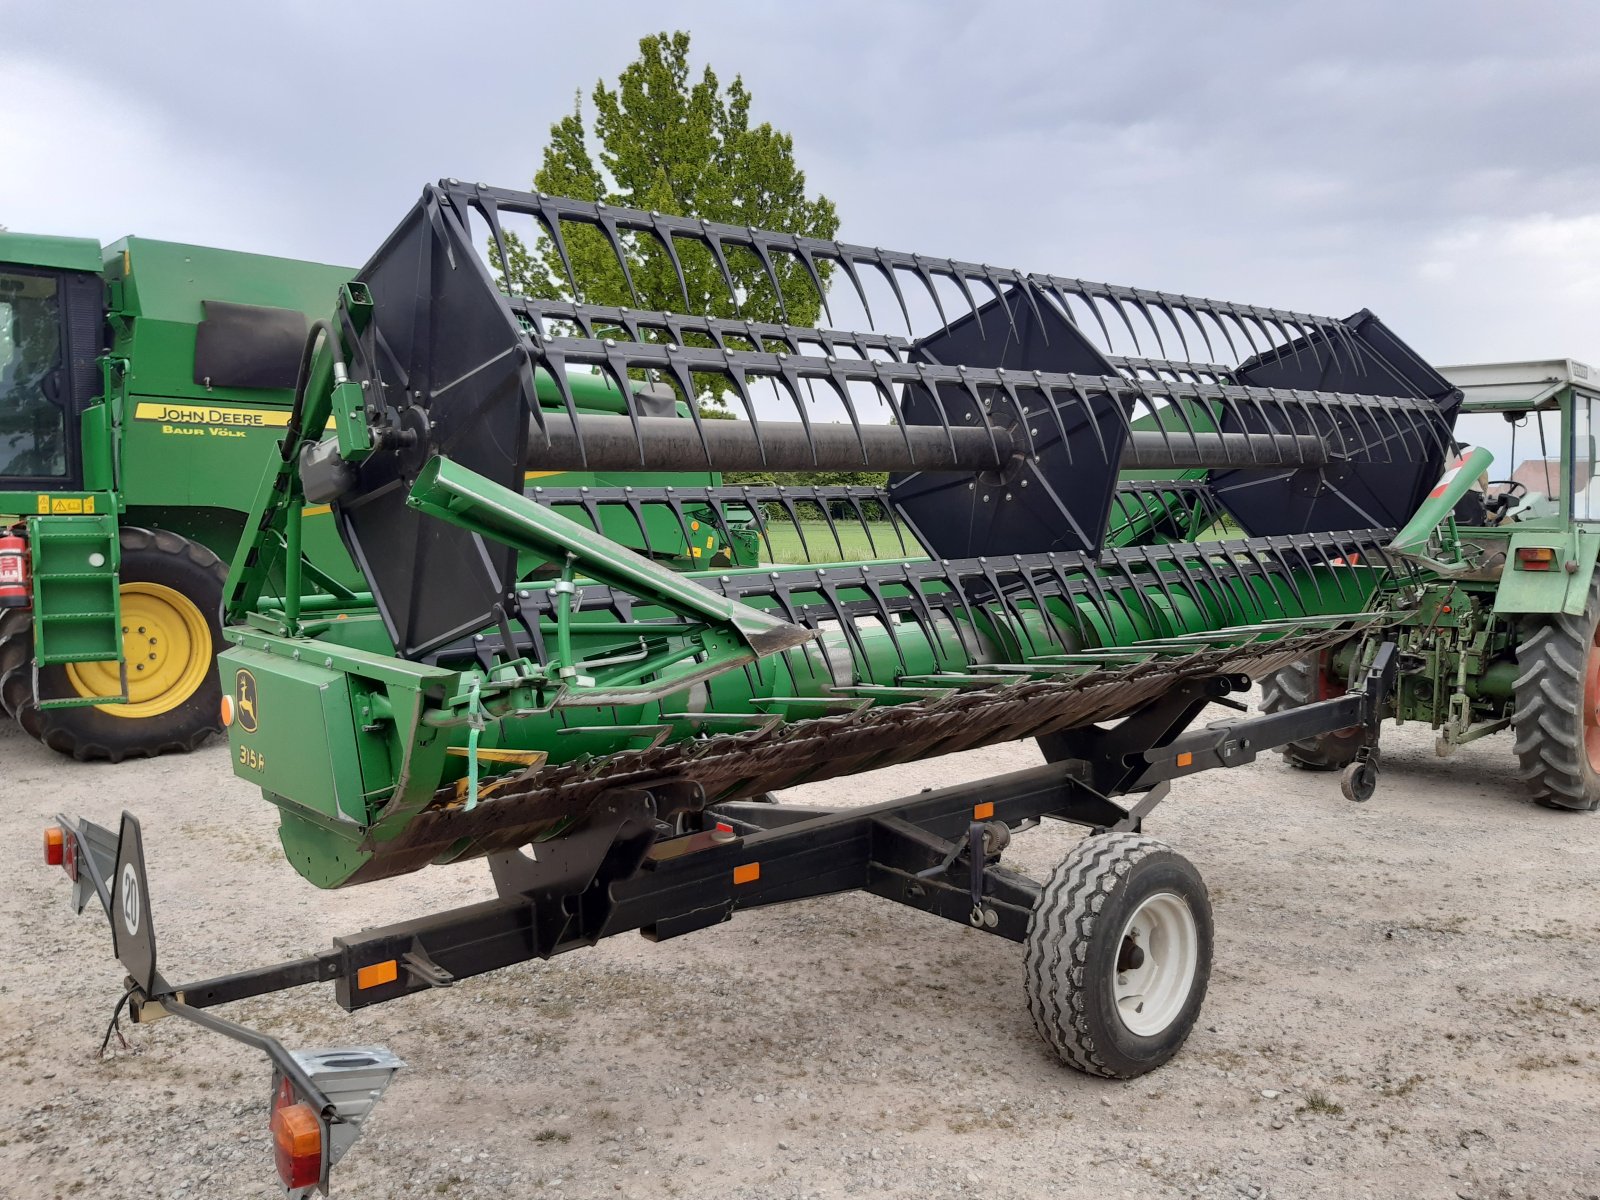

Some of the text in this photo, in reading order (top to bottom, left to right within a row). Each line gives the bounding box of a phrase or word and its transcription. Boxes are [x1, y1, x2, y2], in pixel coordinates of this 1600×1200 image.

[158, 407, 263, 424] JOHN DEERE
[162, 425, 247, 438] BAUR VÖLK
[125, 872, 137, 927] 20
